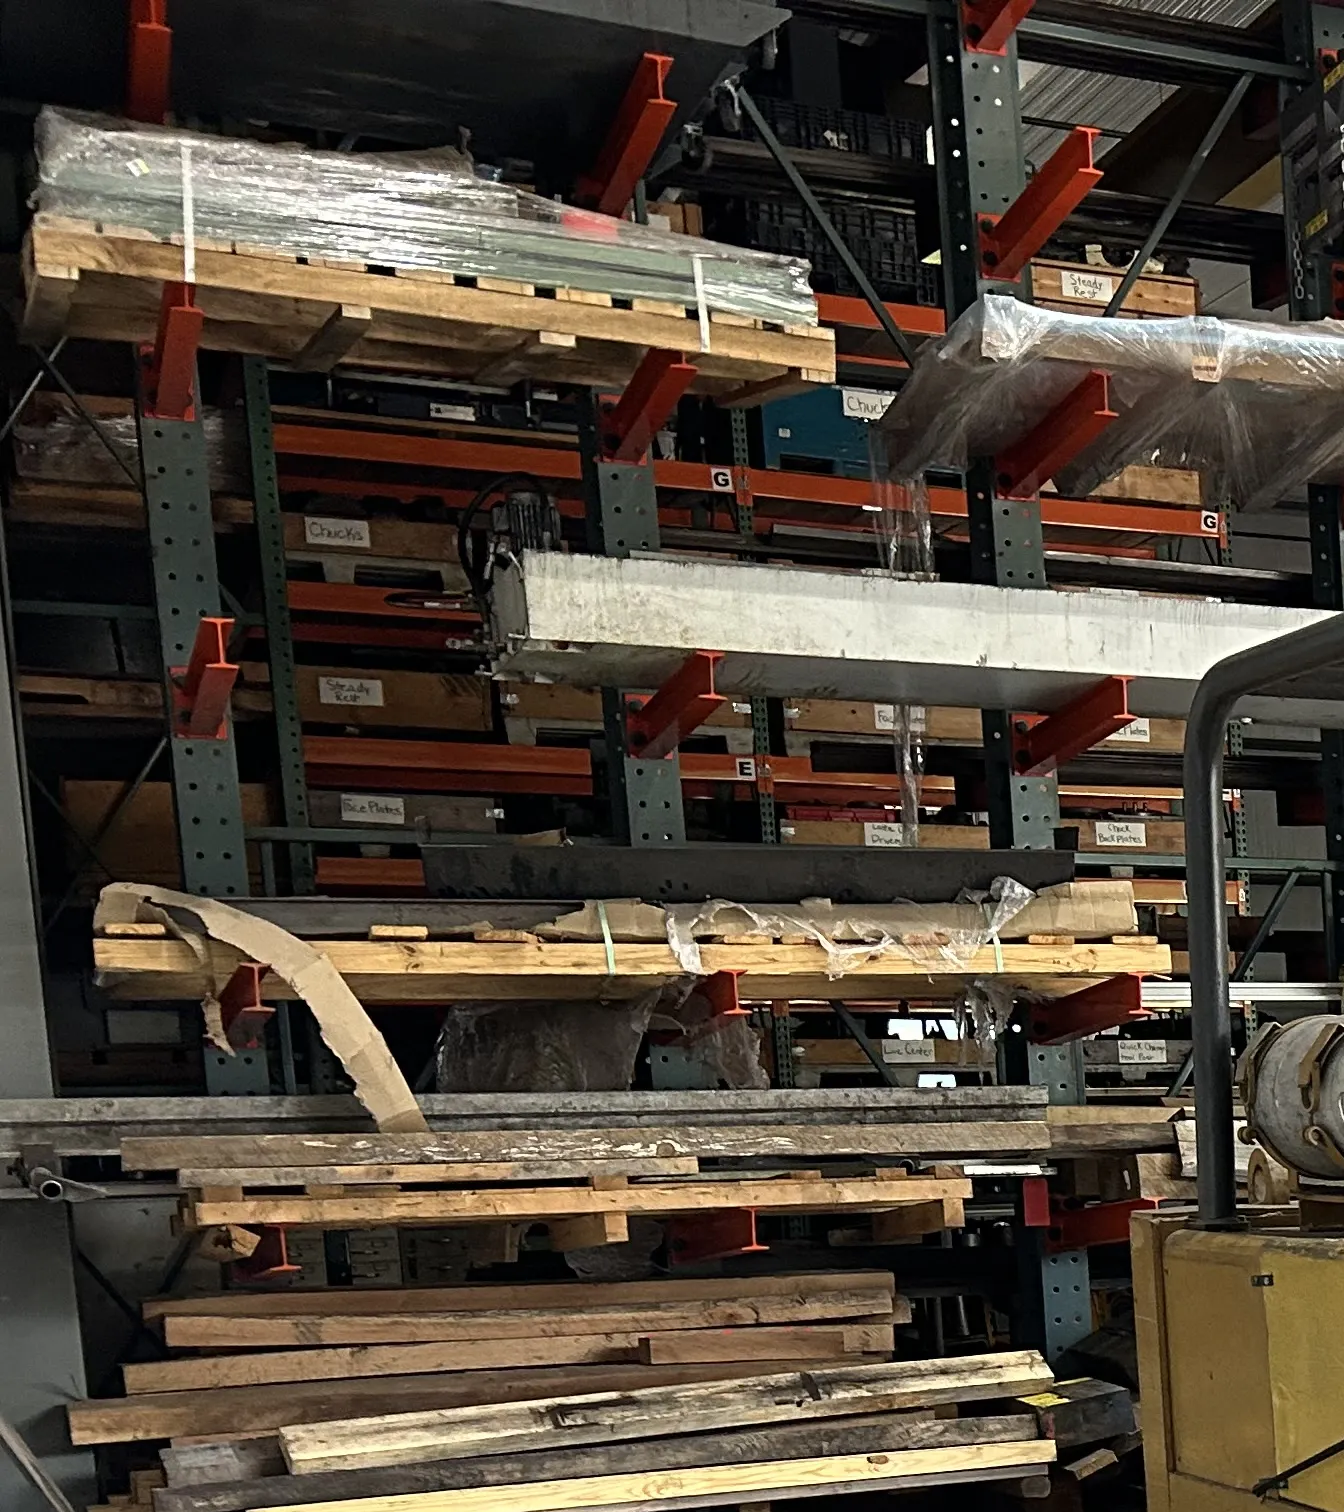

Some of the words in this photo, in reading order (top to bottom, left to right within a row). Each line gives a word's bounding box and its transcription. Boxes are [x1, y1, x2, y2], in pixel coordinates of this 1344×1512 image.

[1070, 273, 1102, 291] Steady
[713, 471, 729, 487] G
[1203, 514, 1216, 529] G
[738, 761, 752, 776] E
